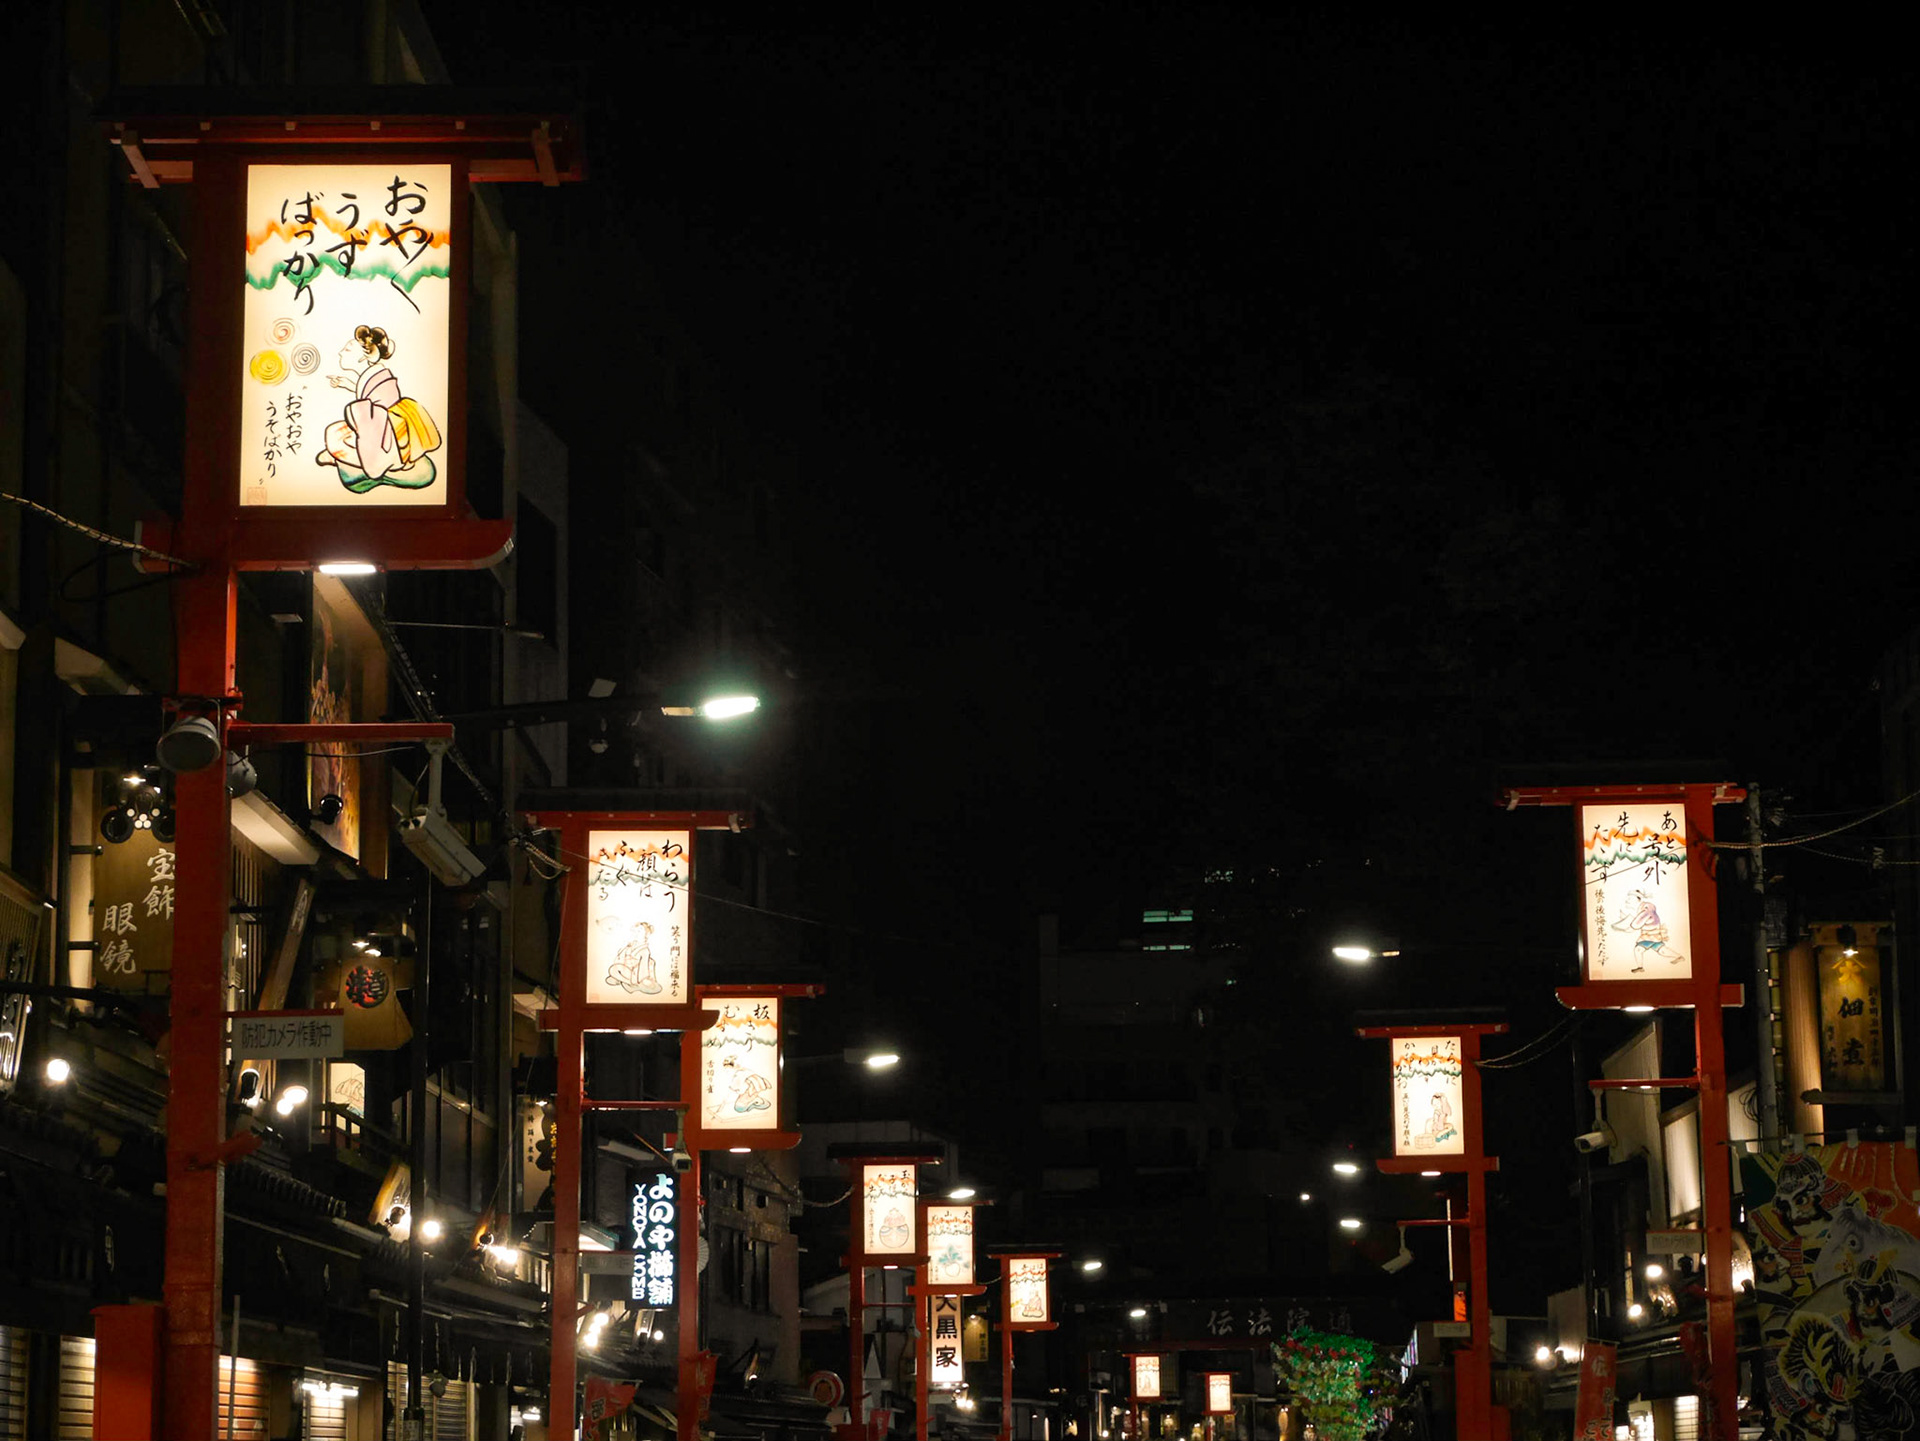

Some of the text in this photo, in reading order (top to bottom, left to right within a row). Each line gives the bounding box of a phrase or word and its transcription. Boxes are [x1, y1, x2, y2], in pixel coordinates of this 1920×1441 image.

[281, 191, 324, 316] ばっかり
[263, 401, 282, 478] うそばかり
[286, 393, 303, 455] おやおや
[1613, 811, 1639, 854] 先に
[1641, 832, 1667, 886] 号外
[143, 847, 176, 920] 宝飾
[662, 838, 683, 913] わらう
[99, 900, 138, 976] 眼鏡
[241, 1019, 333, 1049] 防犯カメラ作動中
[1838, 996, 1865, 1066] 佃煮
[632, 1183, 648, 1300] YONOYA COMB
[935, 1295, 959, 1368] 大黒家
